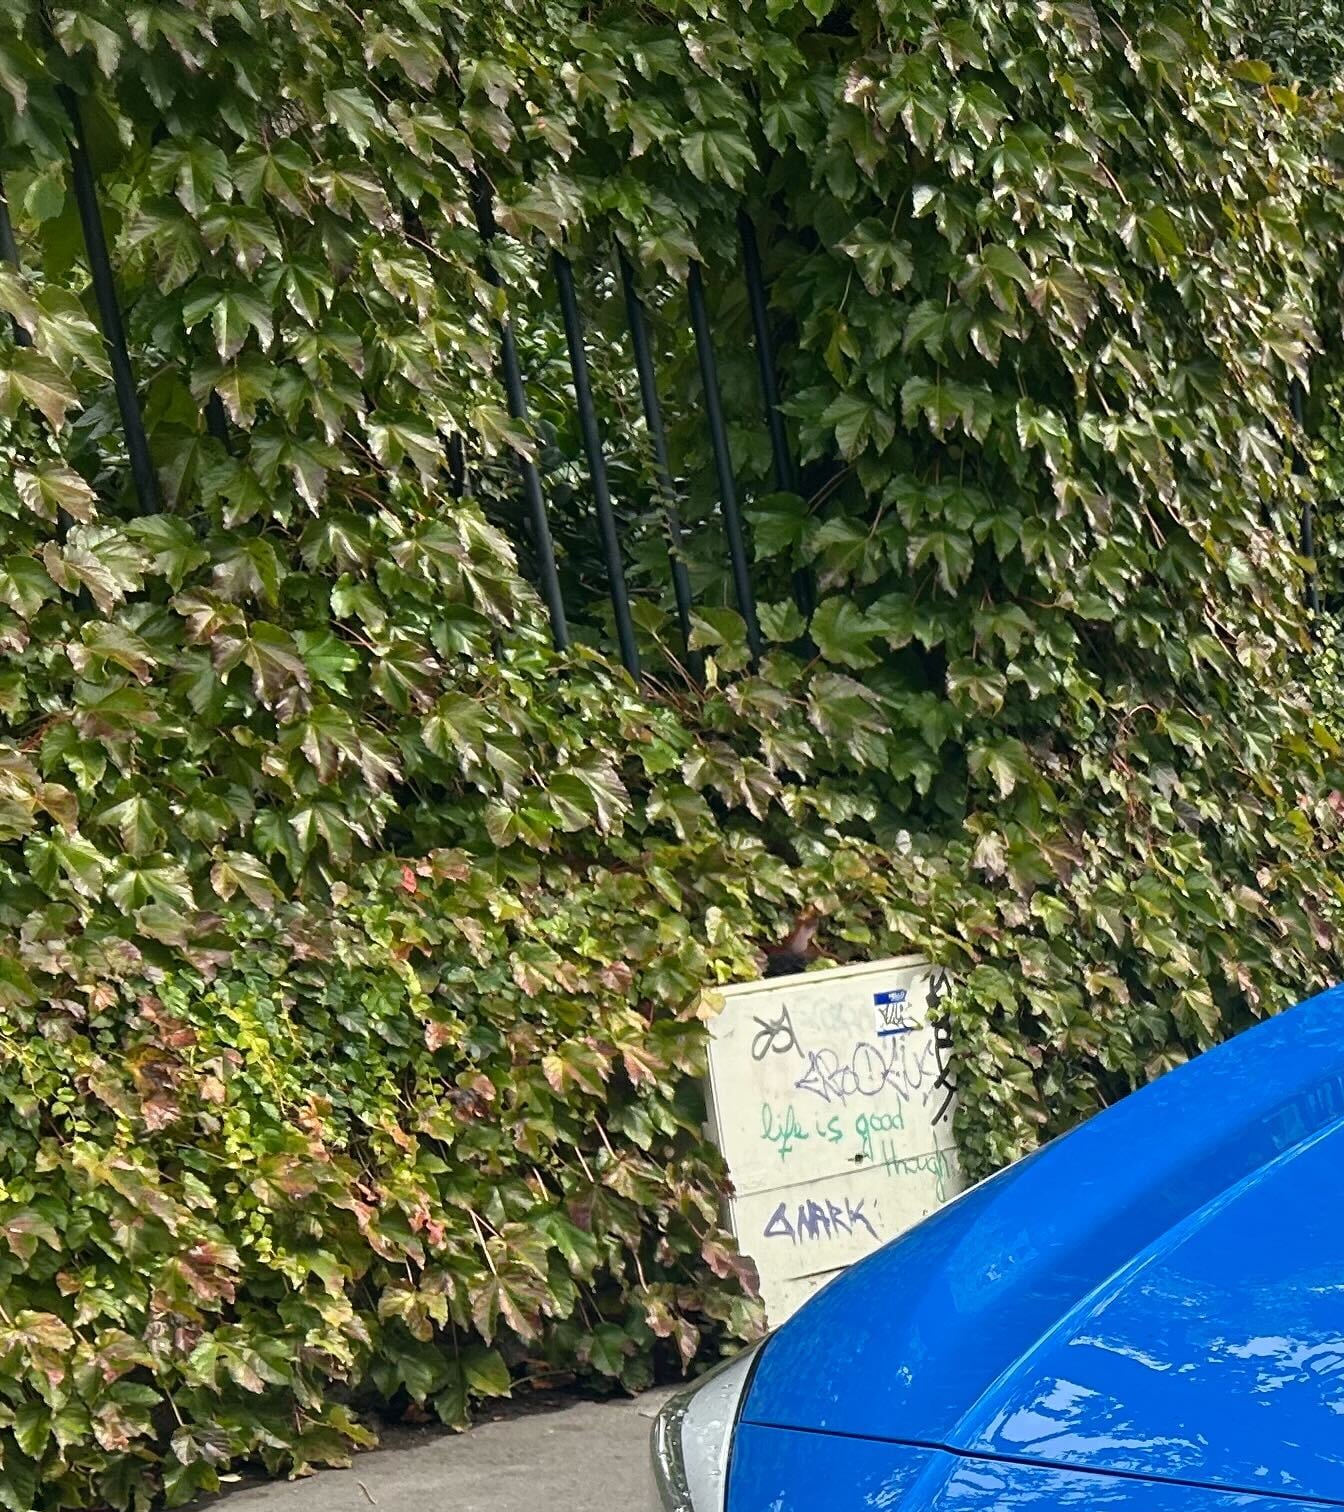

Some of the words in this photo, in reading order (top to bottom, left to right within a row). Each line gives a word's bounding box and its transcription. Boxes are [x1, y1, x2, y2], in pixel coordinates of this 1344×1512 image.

[760, 1102, 809, 1162] life
[816, 1111, 843, 1143] is
[855, 1093, 905, 1162] good
